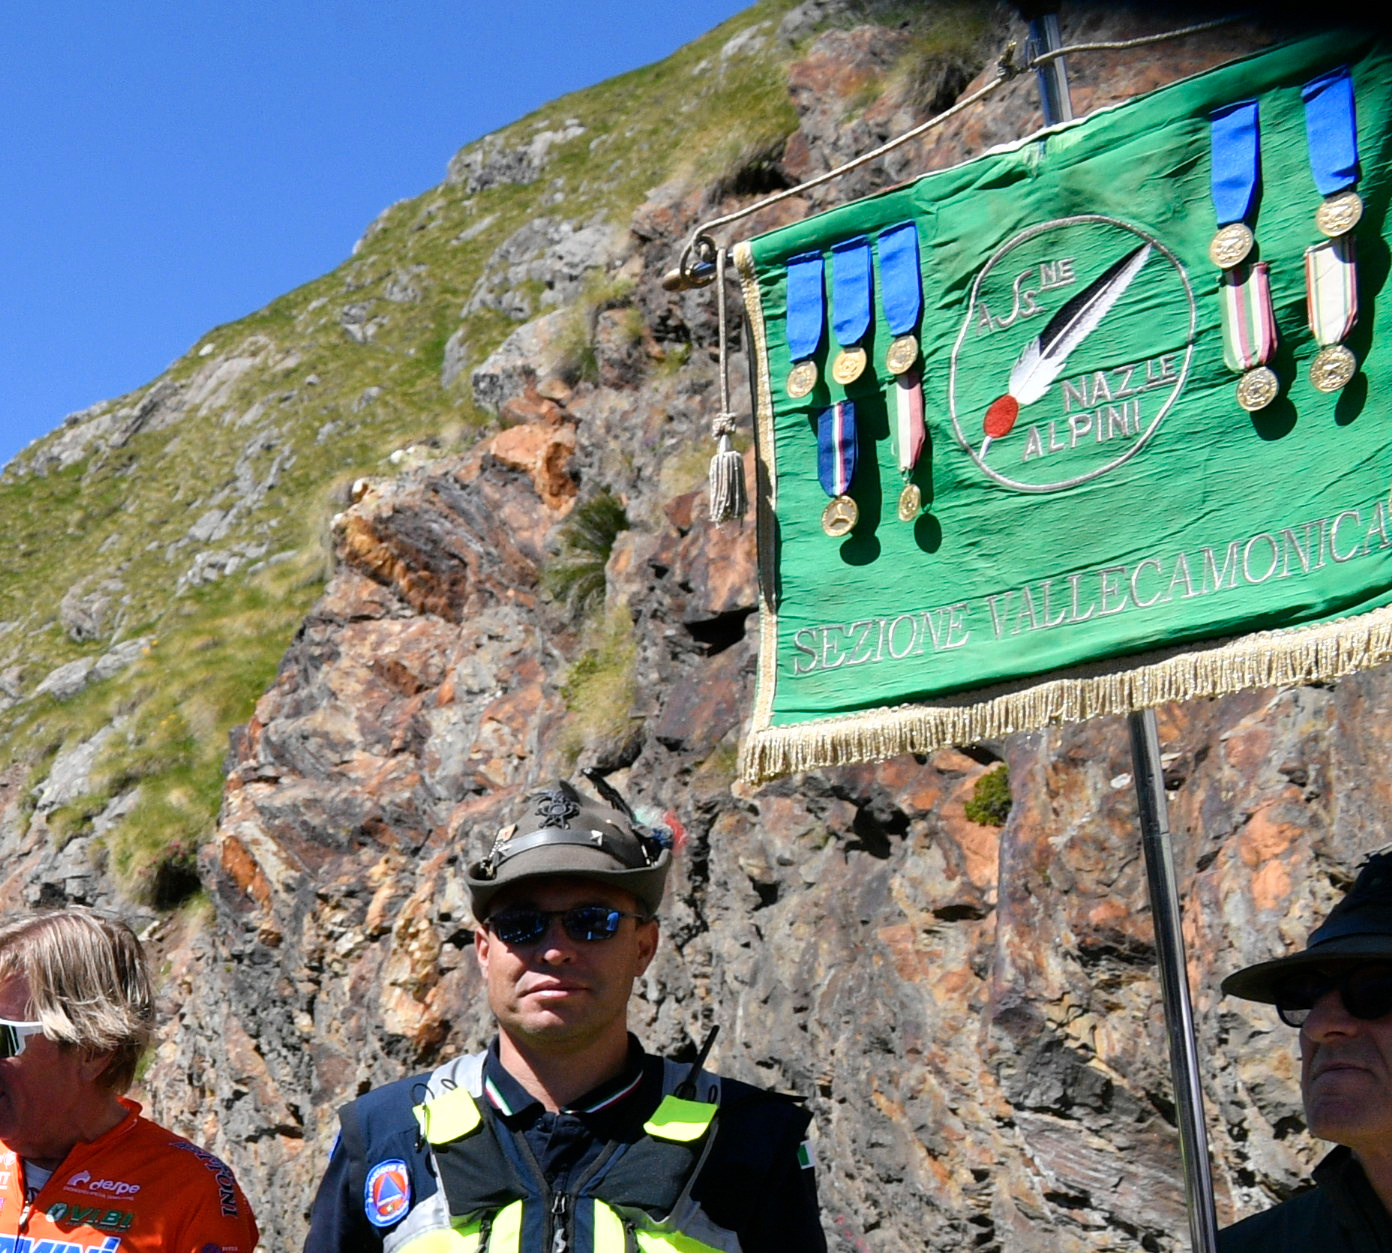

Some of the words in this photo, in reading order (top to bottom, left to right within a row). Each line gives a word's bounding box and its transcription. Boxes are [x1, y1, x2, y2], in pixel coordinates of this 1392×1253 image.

[1023, 400, 1140, 461] ALPINI
[793, 603, 971, 675] SEZIONE
[986, 501, 1391, 641] VALLECAMONICA
[89, 1178, 140, 1195] despe
